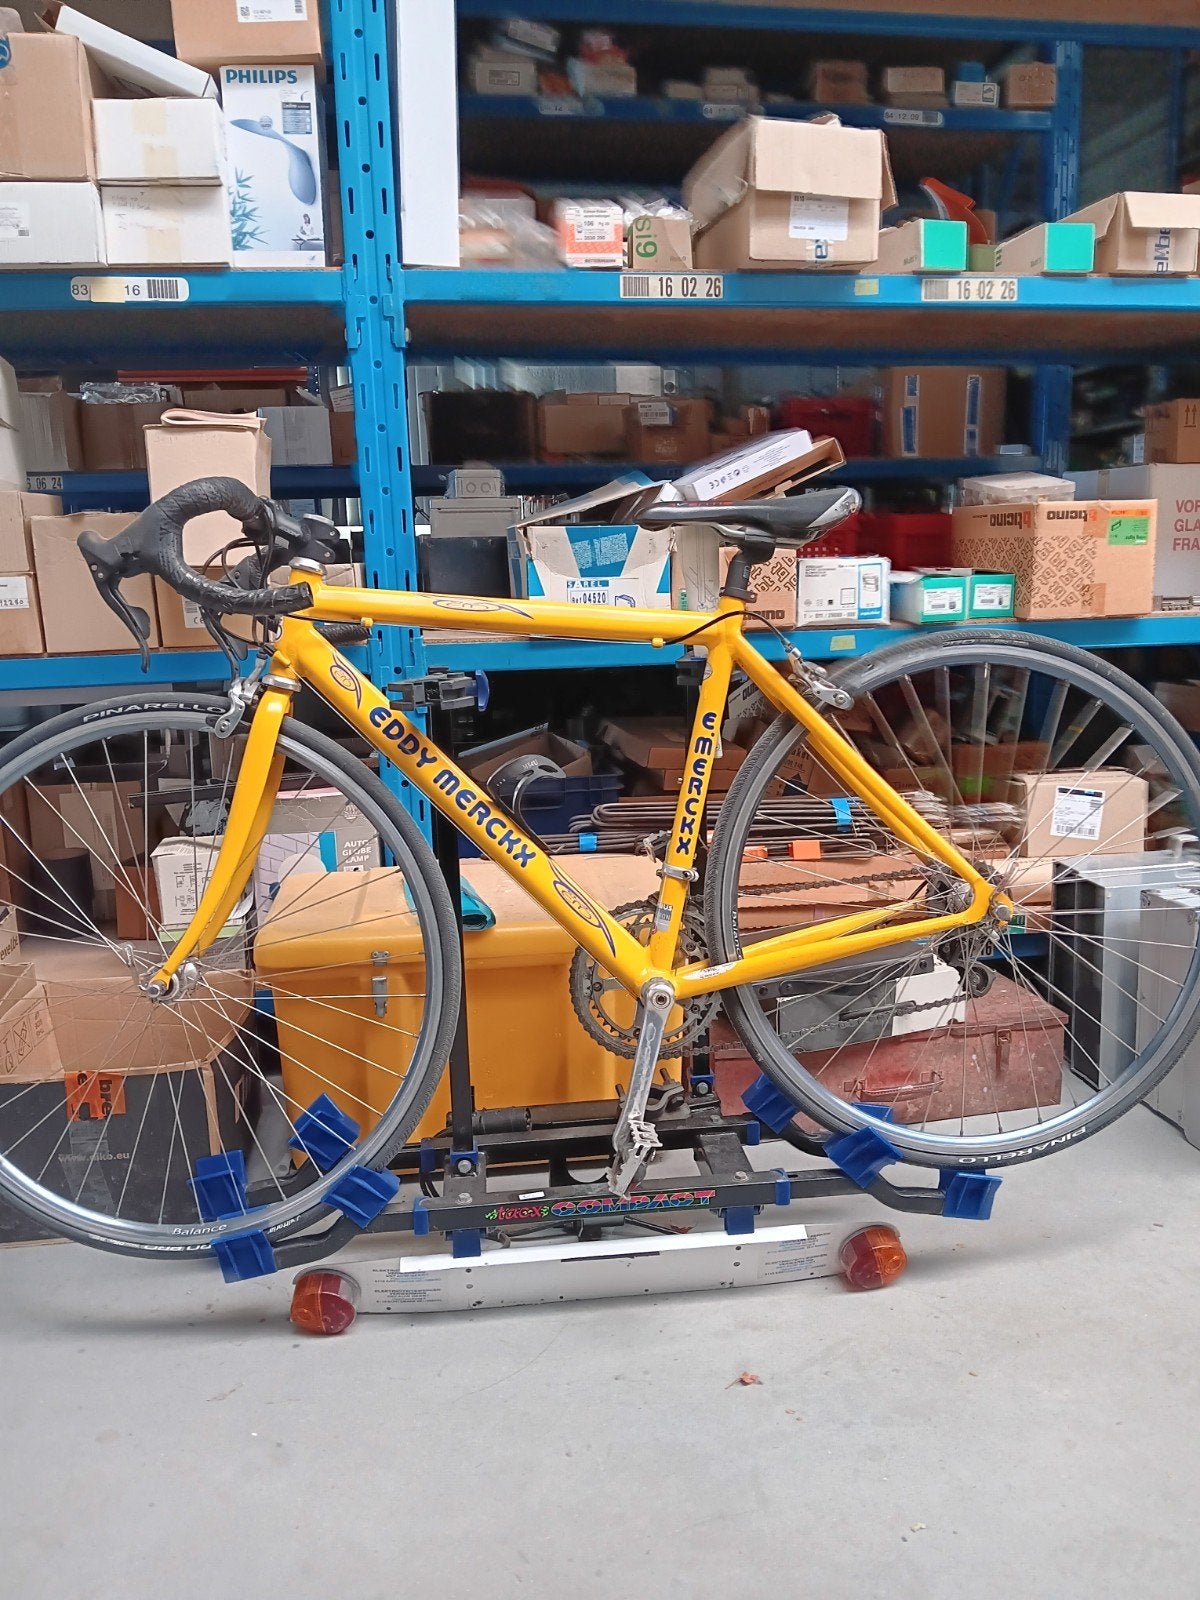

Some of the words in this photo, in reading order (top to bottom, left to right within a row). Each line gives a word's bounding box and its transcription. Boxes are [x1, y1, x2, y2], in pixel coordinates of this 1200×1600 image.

[225, 69, 298, 84] PHILIPS
[71, 284, 88, 296] 83
[124, 285, 141, 296] 16
[658, 277, 673, 297] 16
[681, 278, 697, 297] 02
[705, 278, 721, 298] 26
[957, 281, 971, 299] 16
[978, 281, 994, 299] 02
[1001, 281, 1016, 299] 26
[36, 477, 47, 490] 06
[51, 477, 62, 489] 24
[567, 580, 602, 588] SAREL
[583, 592, 606, 604] 04520
[83, 702, 227, 723] PINARELLO
[369, 706, 438, 768] EDDY
[433, 769, 537, 868] MERCKX
[342, 846, 372, 856] GLOBE
[958, 1126, 1087, 1163] PINARELLO
[550, 1189, 716, 1216] COMPACT
[172, 1224, 228, 1236] Balance
